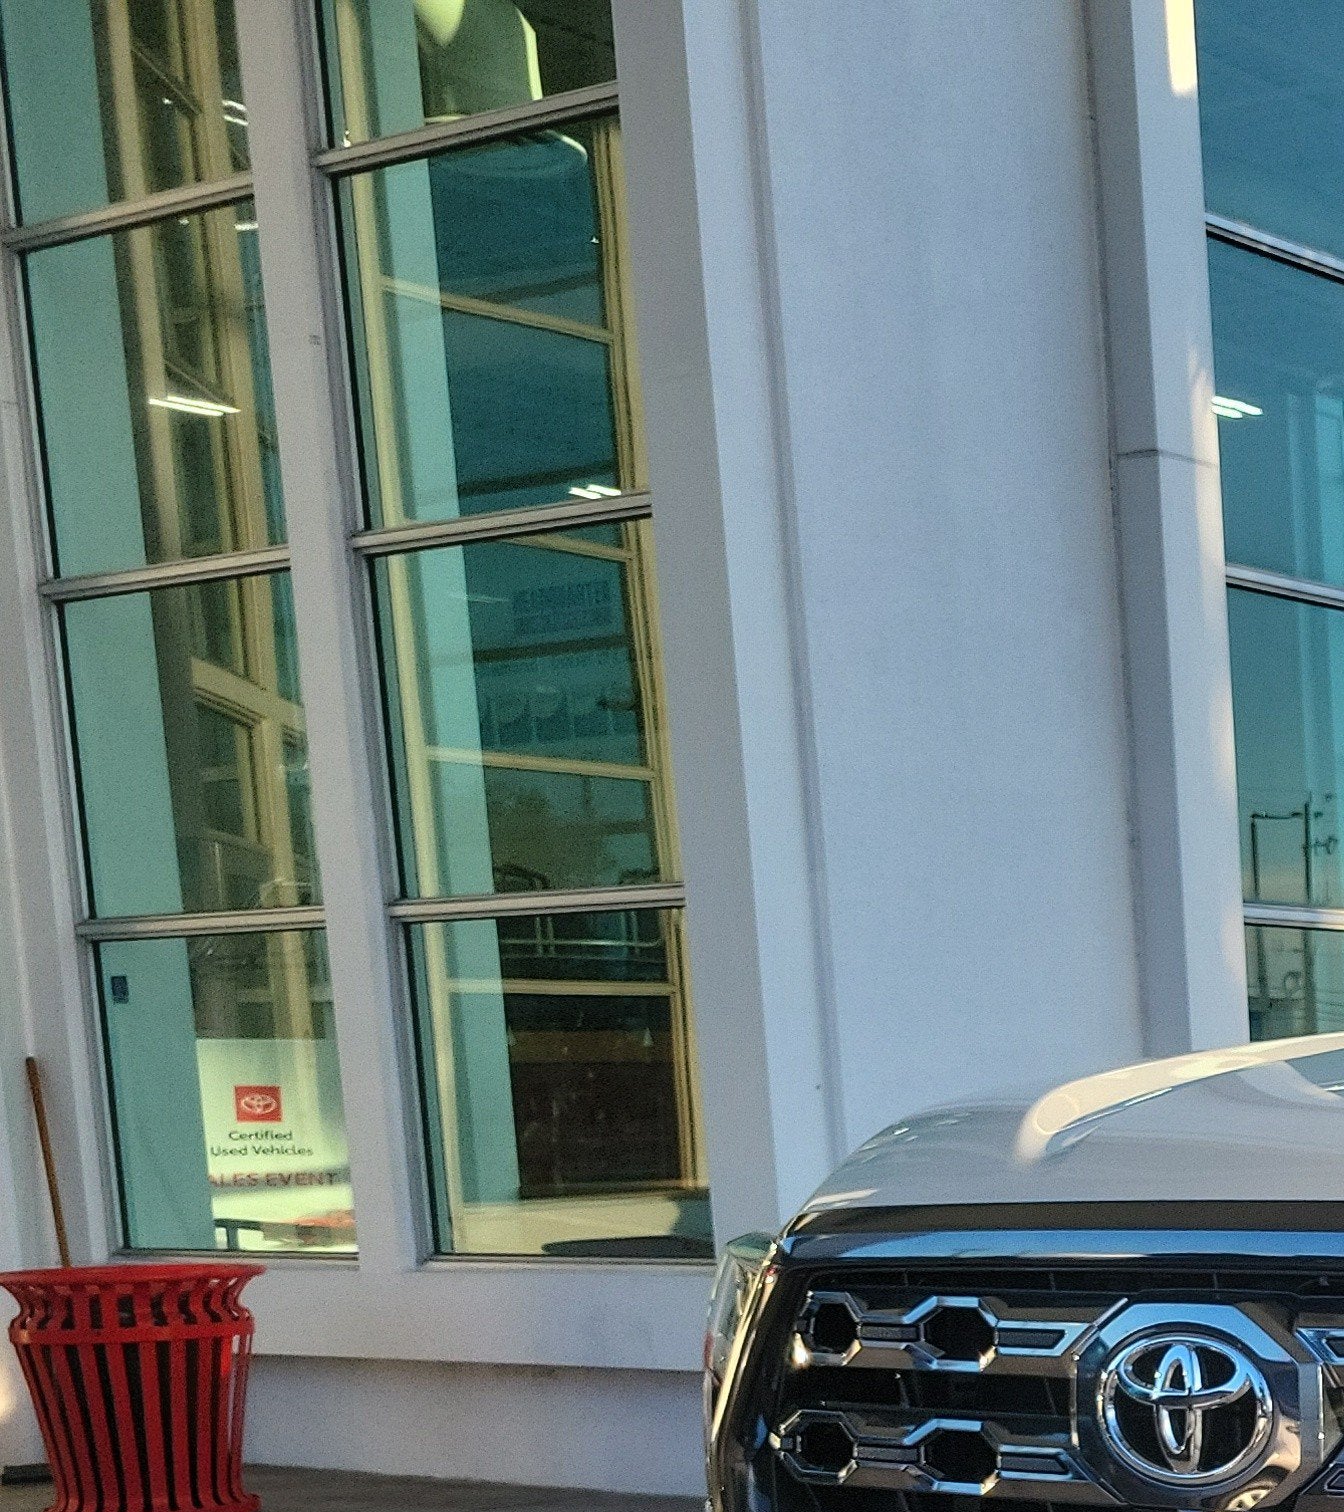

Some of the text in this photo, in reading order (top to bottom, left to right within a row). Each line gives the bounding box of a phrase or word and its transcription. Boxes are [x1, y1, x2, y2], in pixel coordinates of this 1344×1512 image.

[228, 1130, 293, 1141] Certified
[210, 1144, 314, 1157] Used Vehicles
[264, 1171, 338, 1187] EVENT
